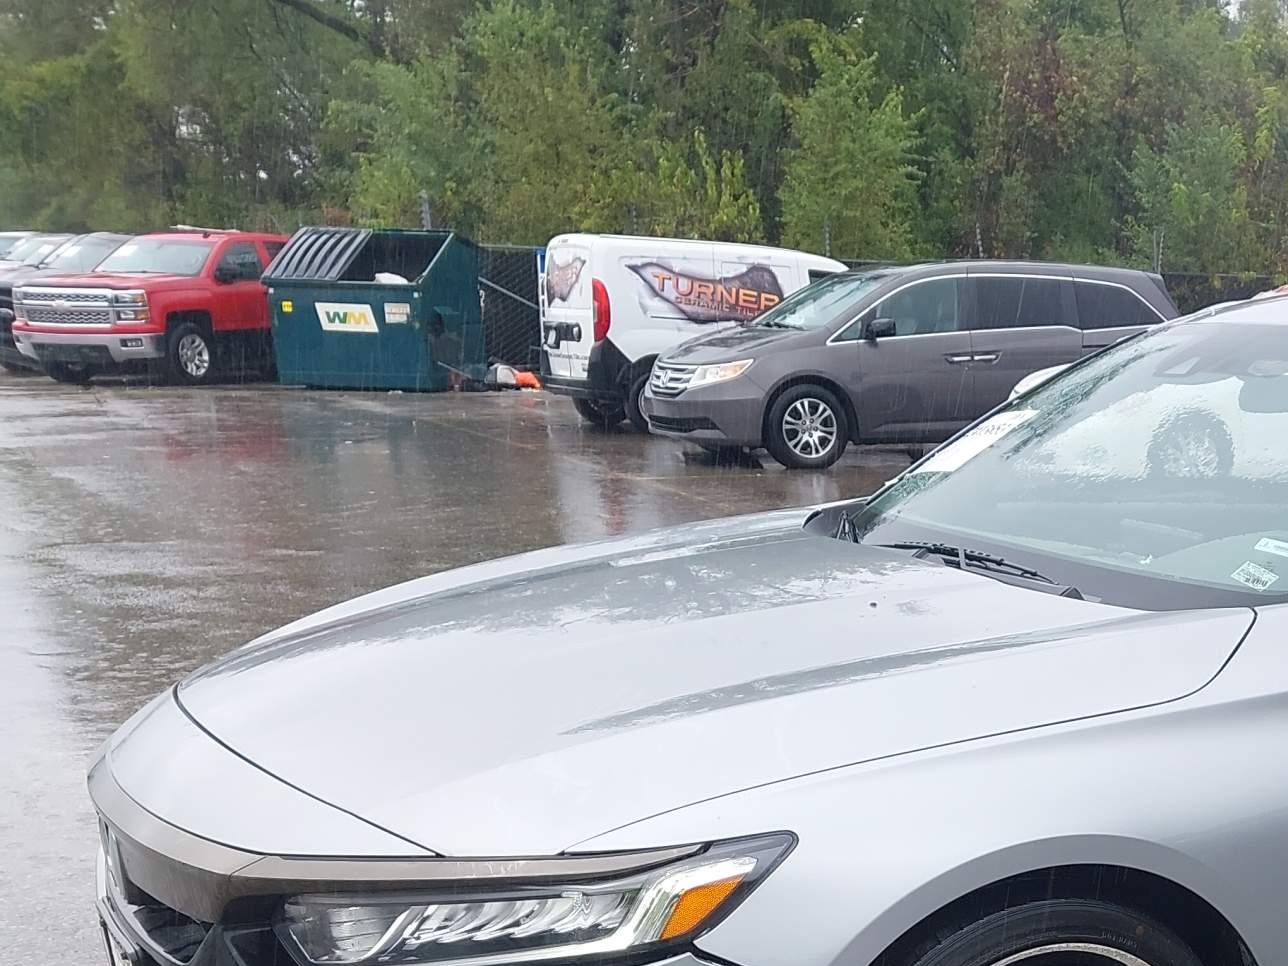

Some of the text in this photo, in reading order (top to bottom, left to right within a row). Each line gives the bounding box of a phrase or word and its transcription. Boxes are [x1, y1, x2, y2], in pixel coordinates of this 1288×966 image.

[653, 272, 780, 310] TURNER
[674, 296, 731, 312] CERAMIC
[325, 311, 369, 325] WM
